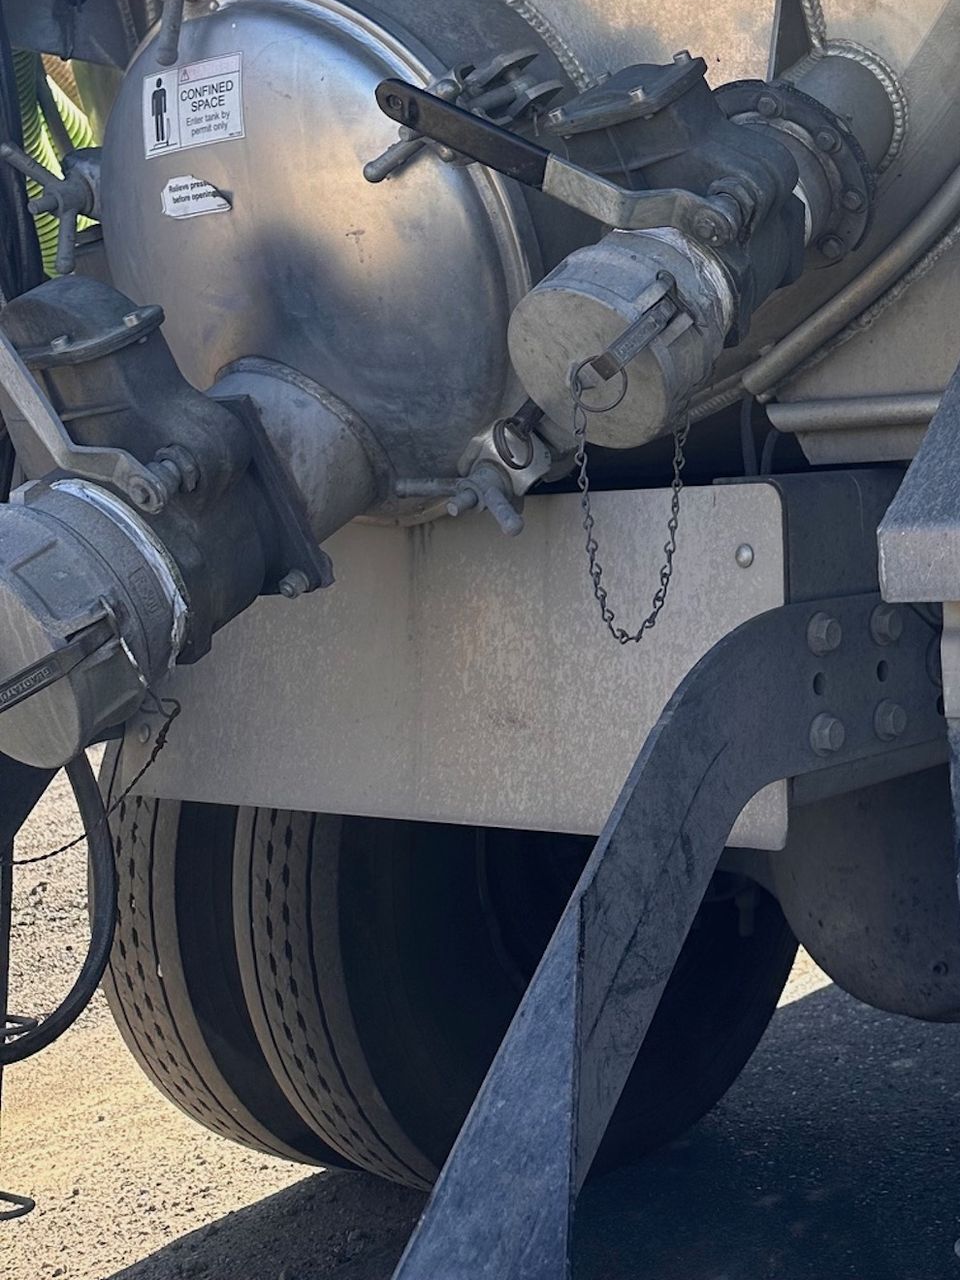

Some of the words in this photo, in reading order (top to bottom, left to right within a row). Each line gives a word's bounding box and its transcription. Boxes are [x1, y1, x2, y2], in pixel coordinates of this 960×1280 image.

[180, 80, 233, 101] CONFINED
[191, 95, 225, 112] SPACE
[186, 116, 204, 127] Enter
[205, 112, 220, 122] tank
[221, 110, 231, 121] by
[191, 124, 211, 137] permit
[213, 120, 229, 132] only
[172, 195, 191, 204] before
[0, 667, 52, 703] GLADIATO
